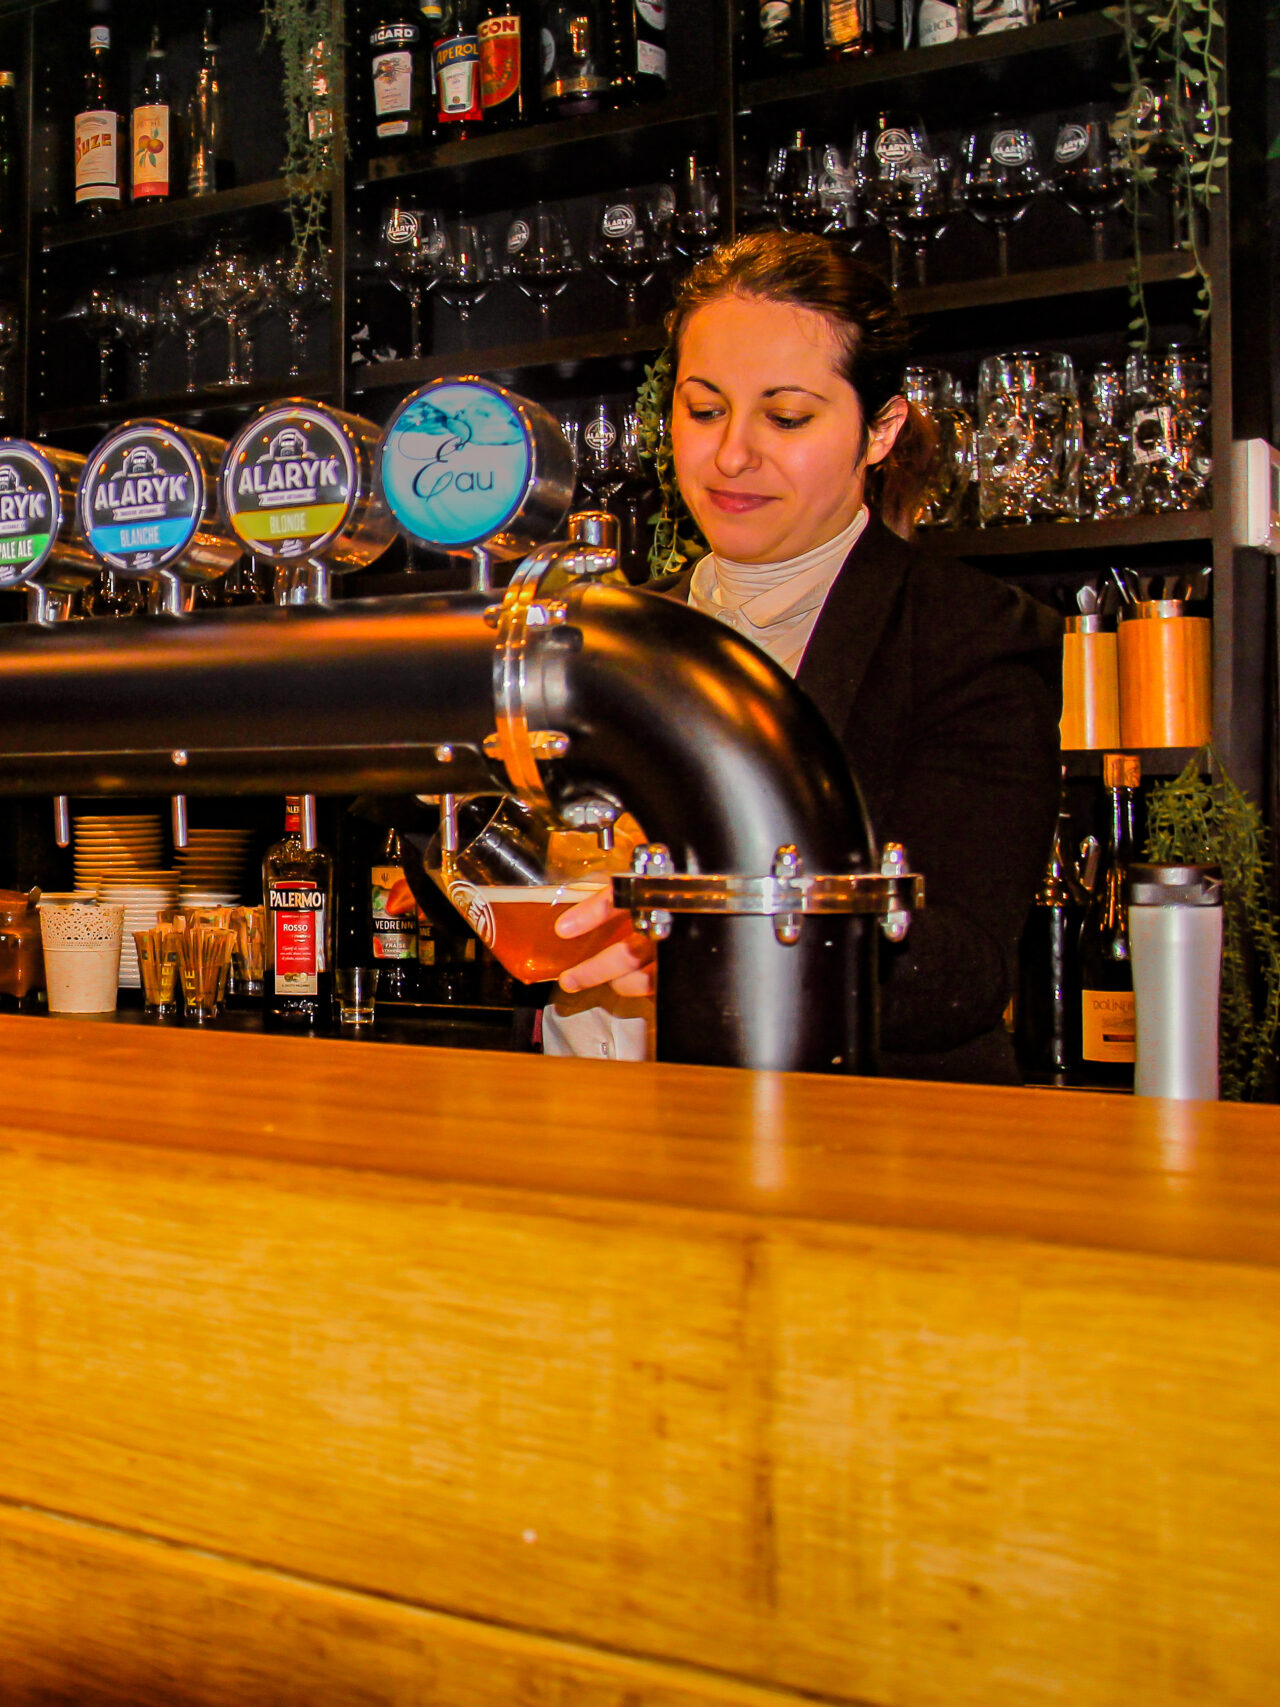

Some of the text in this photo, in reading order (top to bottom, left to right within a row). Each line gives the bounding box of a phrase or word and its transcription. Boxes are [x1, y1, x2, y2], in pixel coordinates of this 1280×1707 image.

[436, 43, 479, 65] APEROL
[398, 419, 493, 503] Eau
[238, 459, 339, 495] ALARYK
[95, 475, 188, 511] ALARYK
[271, 512, 306, 534] BLONDE
[120, 526, 160, 548] BLANCHE
[17, 539, 33, 558] ALE
[269, 890, 322, 908] PALERMO
[283, 923, 308, 932] ROSSO
